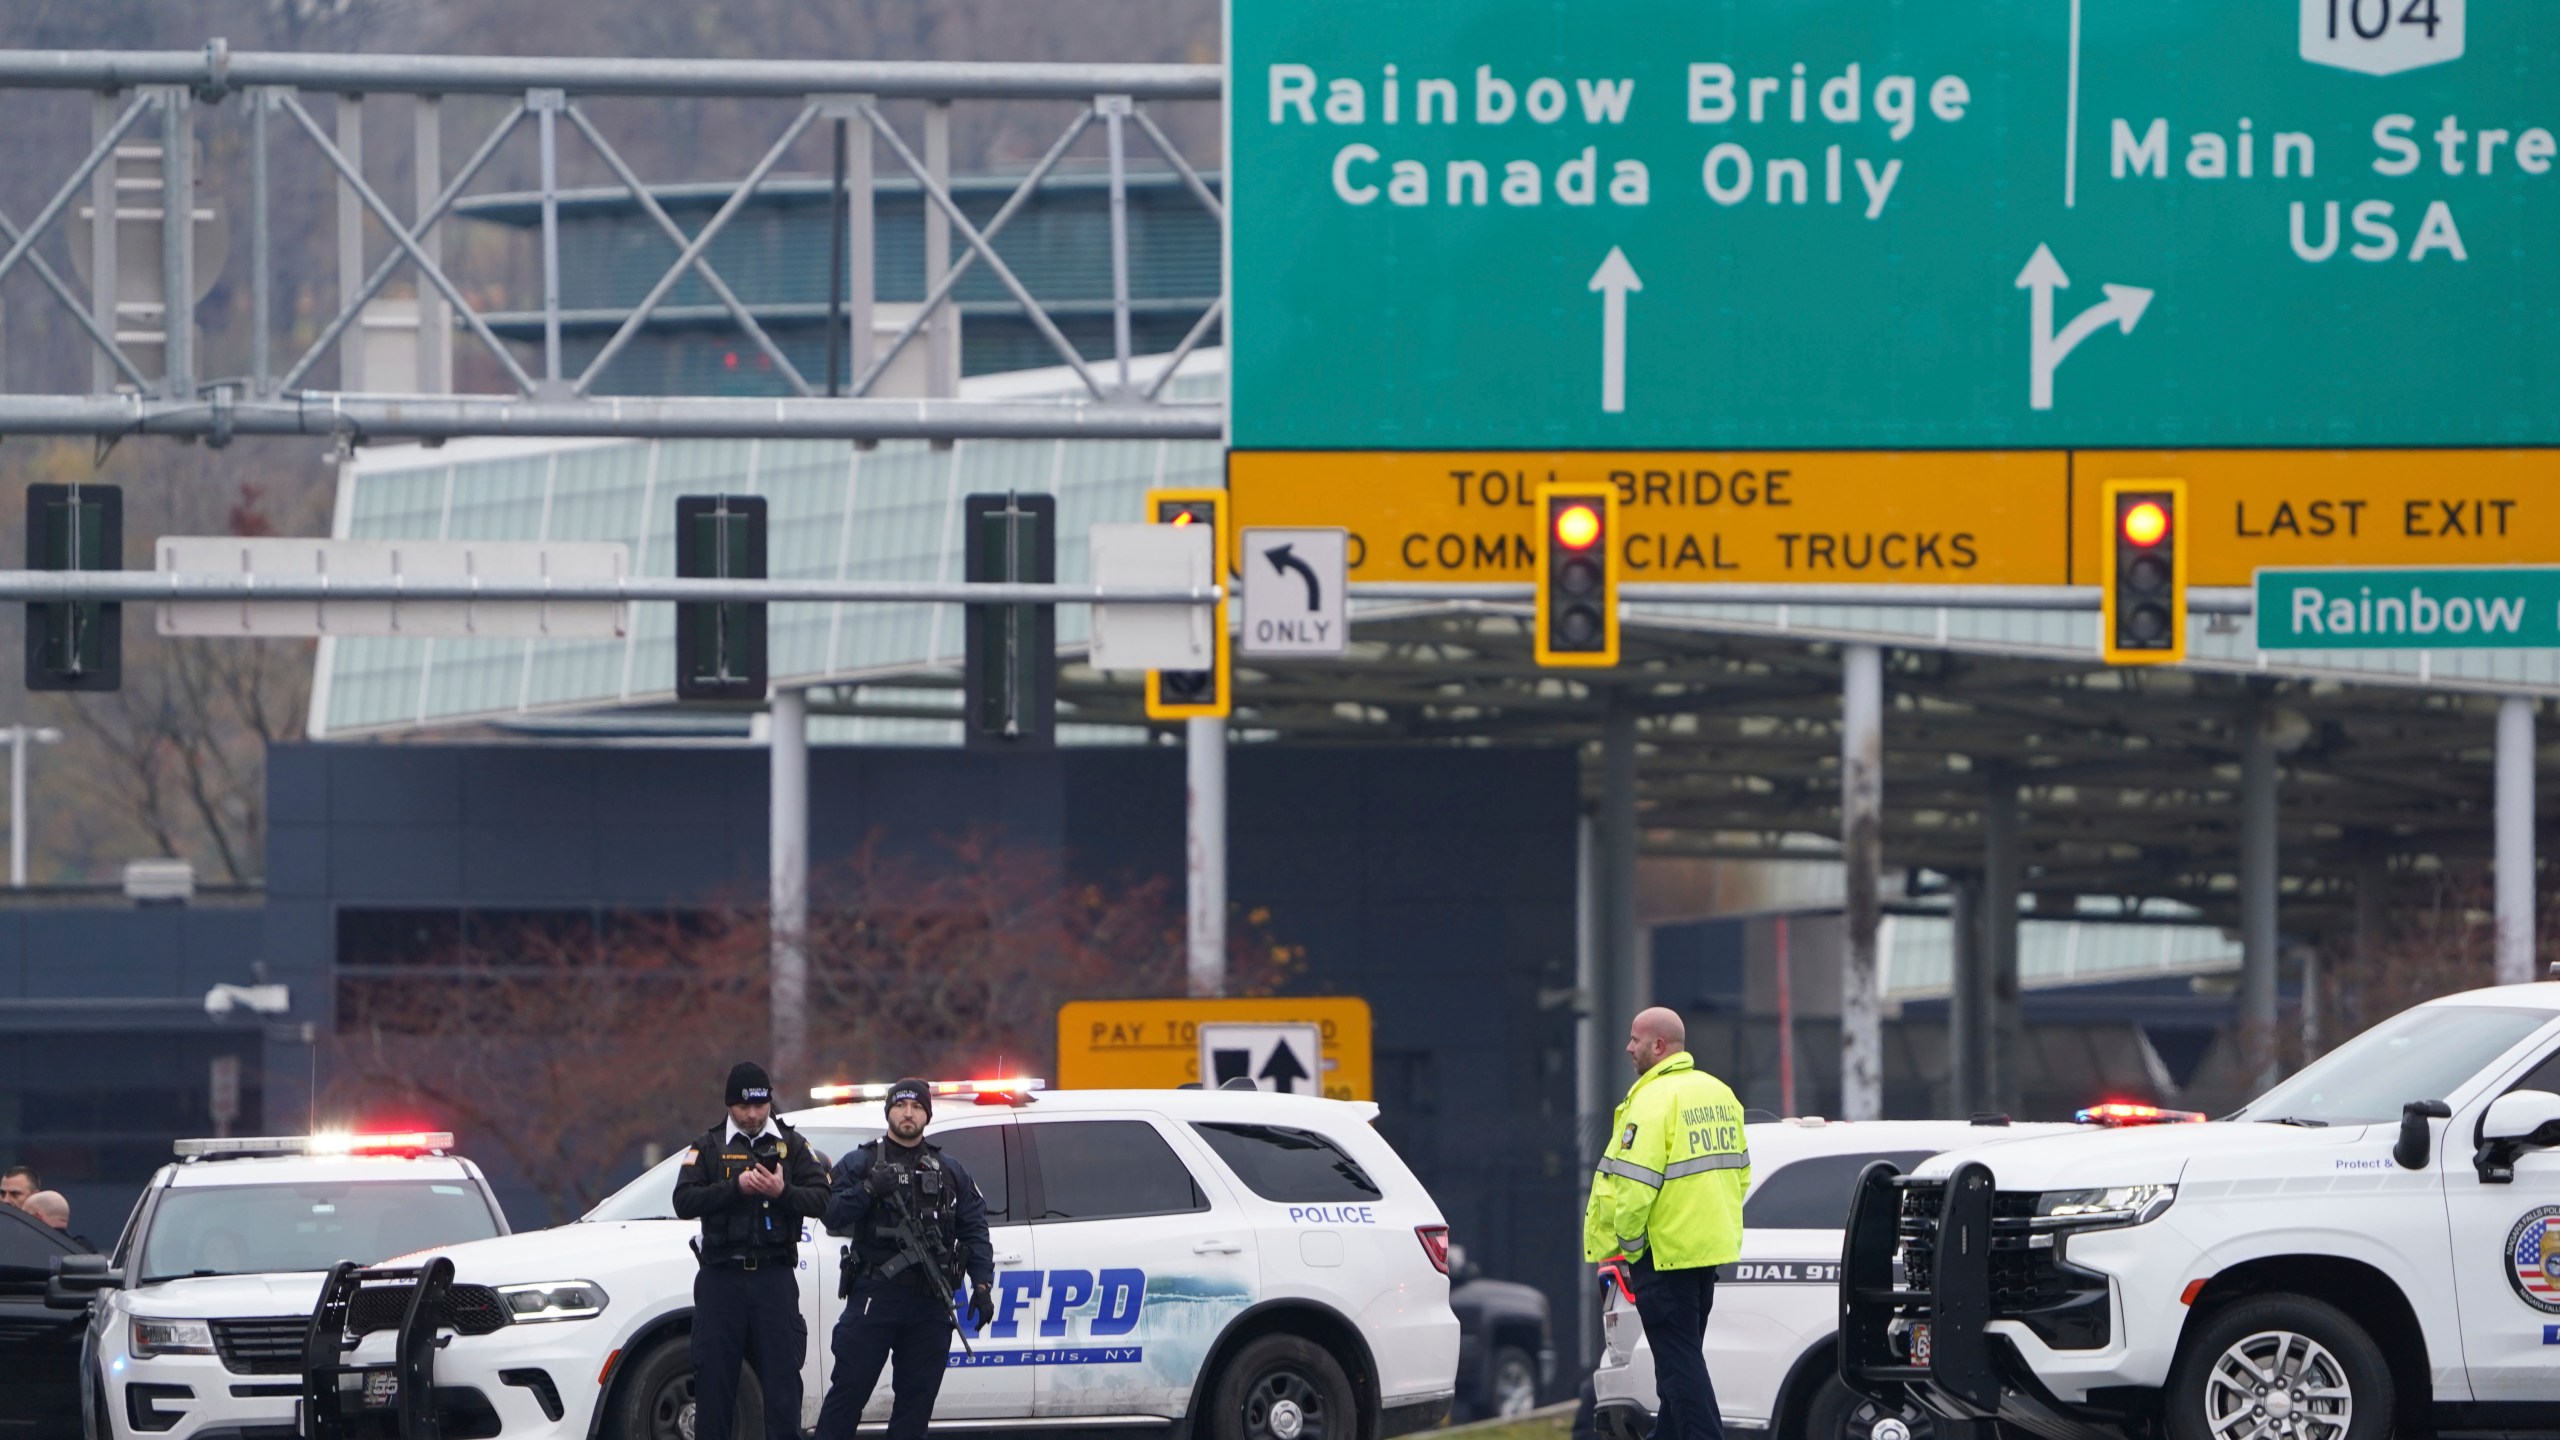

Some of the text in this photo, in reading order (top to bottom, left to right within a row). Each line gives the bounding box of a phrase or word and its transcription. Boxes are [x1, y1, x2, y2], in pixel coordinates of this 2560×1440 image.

[2325, 0, 2441, 39] 104
[1269, 62, 1971, 141] Rainbow Bridge
[2110, 117, 2315, 179] Main
[1332, 143, 1903, 220] Canada Only
[2289, 200, 2468, 262] USA
[1449, 470, 1792, 506] TOL BRIDGE
[2236, 500, 2517, 537] LAST EXIT
[1402, 533, 1740, 570] COMMCIAL
[1776, 533, 1979, 570] TRUCKS
[2292, 586, 2526, 634] Rainbow
[1257, 619, 1331, 643] ONLY
[1090, 1021, 1145, 1043] PAY
[1688, 1126, 1738, 1155] POLICE
[2336, 1158, 2394, 1169] Protect &
[1289, 1206, 1376, 1224] POLICE
[1736, 1265, 1798, 1280] DIAL
[1020, 1350, 1089, 1364] Falls,
[1105, 1349, 1136, 1361] NY
[373, 1376, 398, 1394] 55
